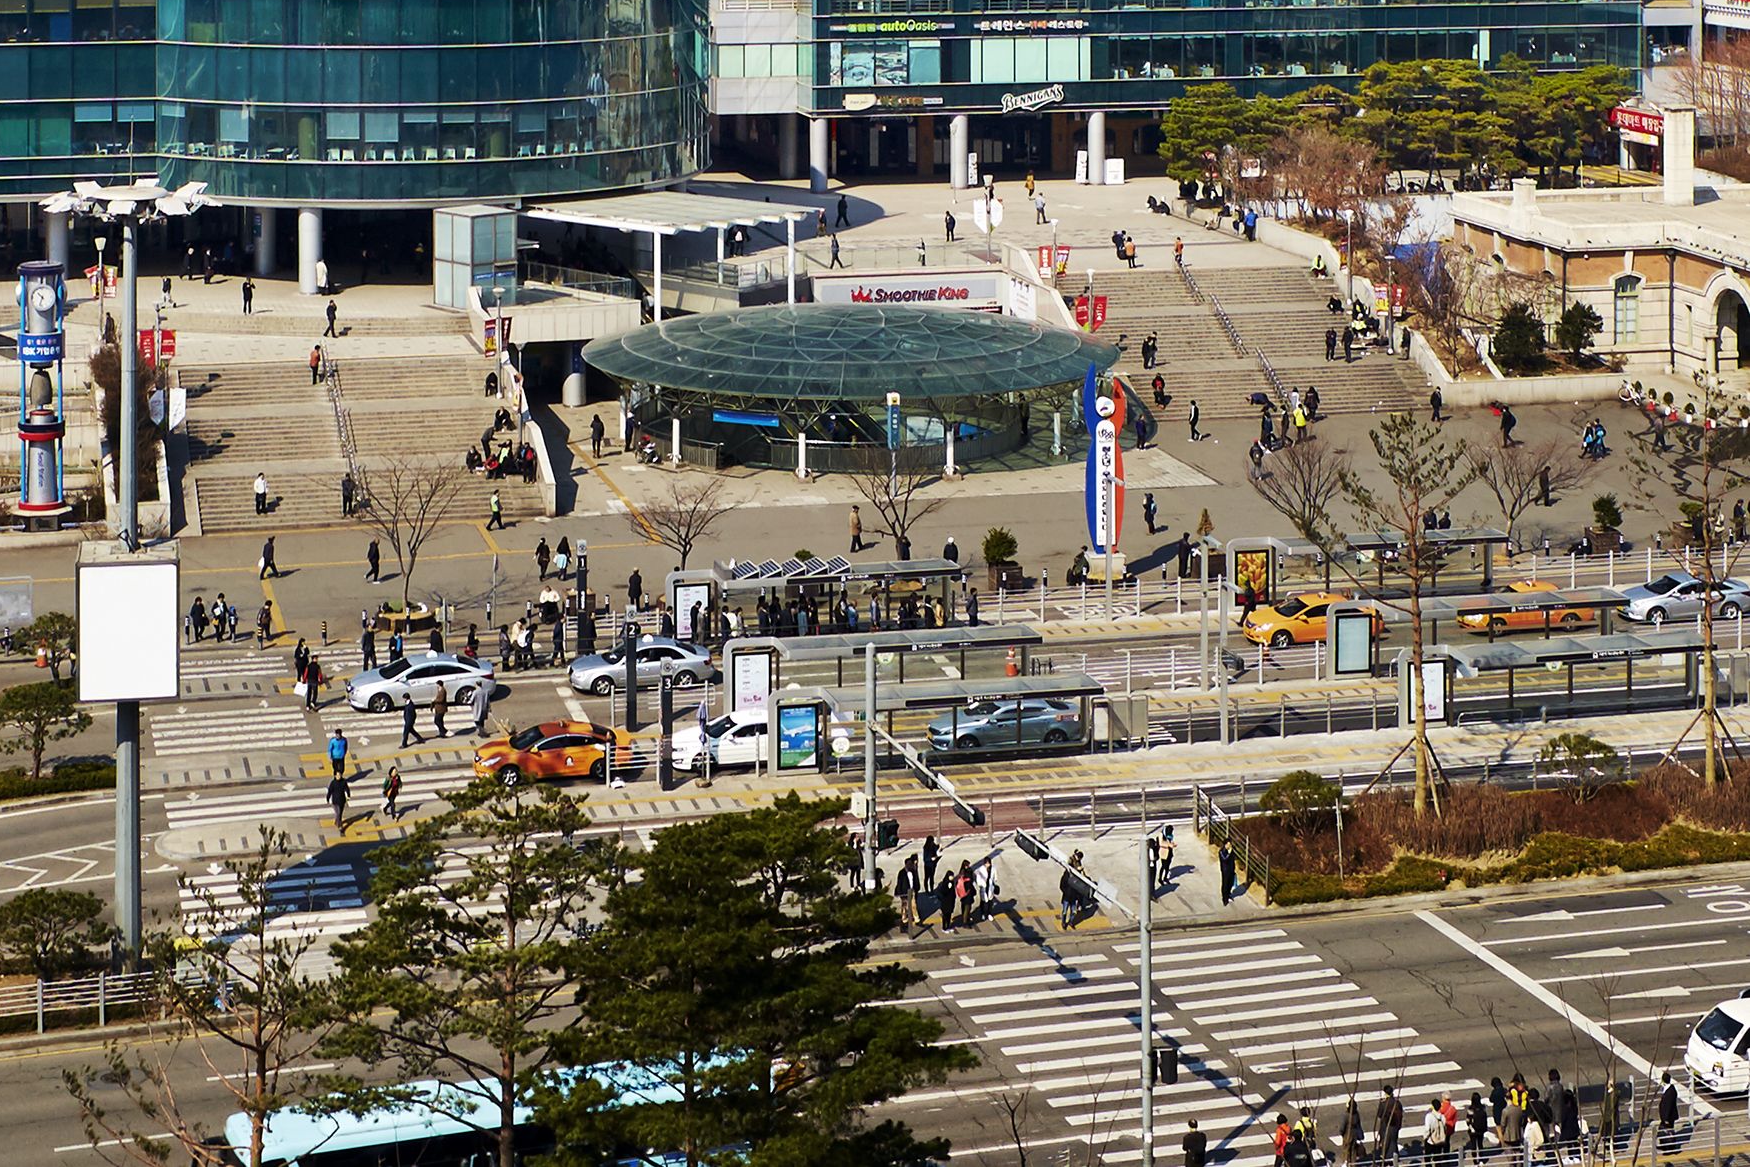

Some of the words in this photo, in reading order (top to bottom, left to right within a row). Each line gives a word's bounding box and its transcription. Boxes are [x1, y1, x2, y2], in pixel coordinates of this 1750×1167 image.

[880, 19, 938, 32] autoOasis
[874, 288, 936, 303] SMOOTHIE
[937, 286, 970, 301] KING
[628, 624, 636, 635] 2
[664, 677, 671, 690] 3
